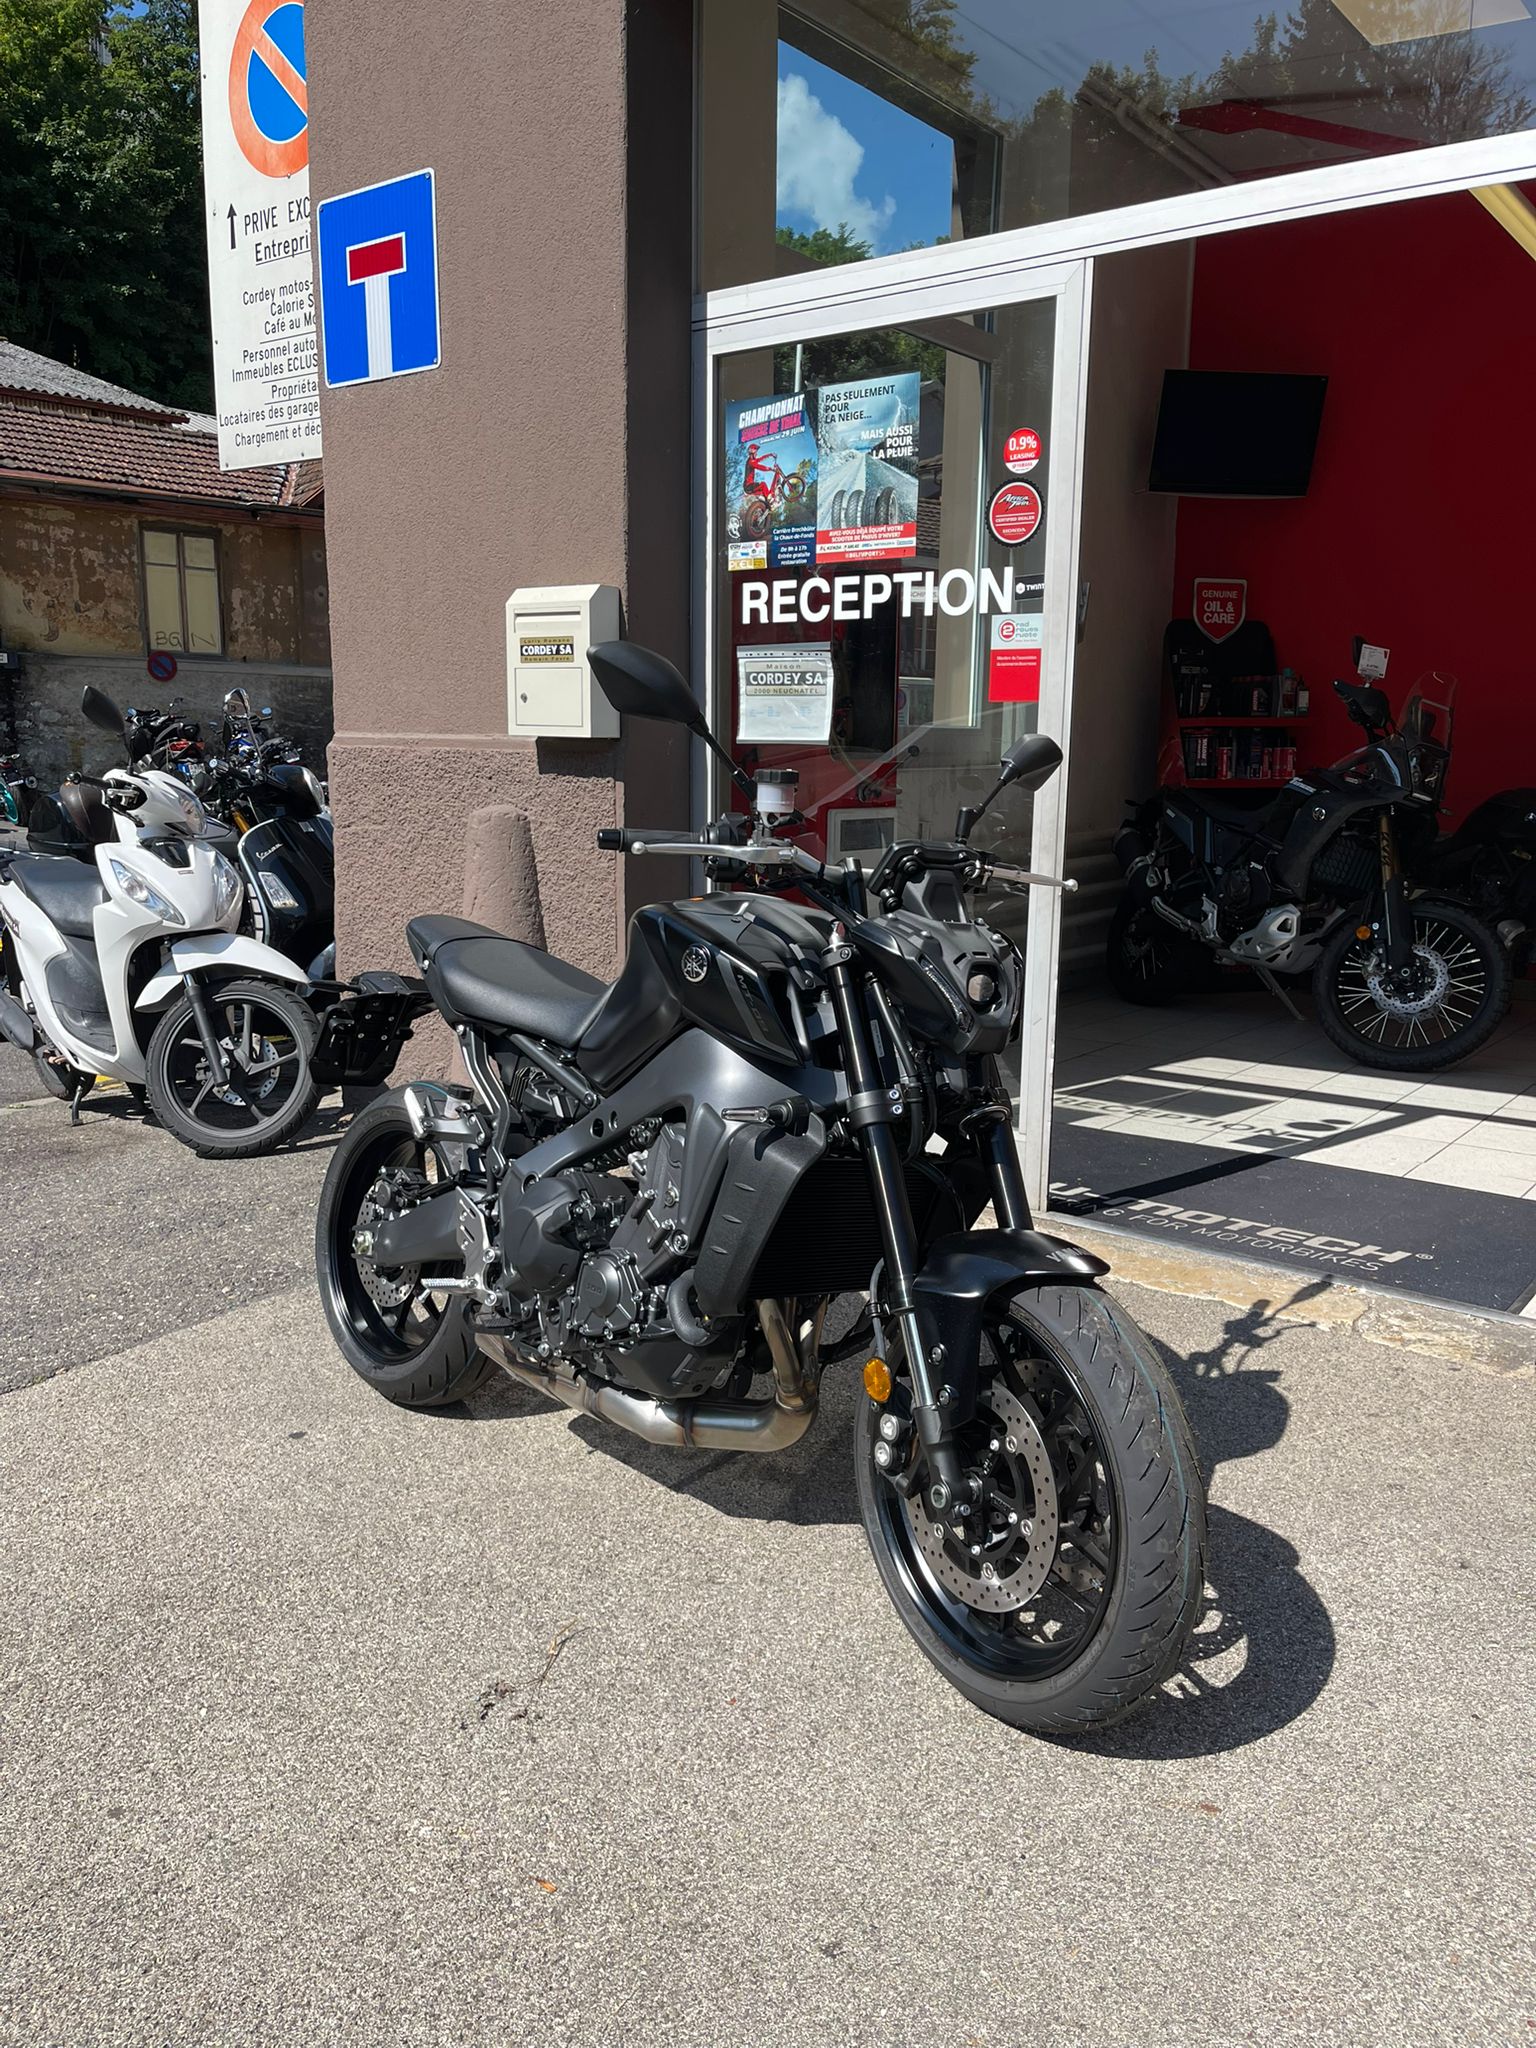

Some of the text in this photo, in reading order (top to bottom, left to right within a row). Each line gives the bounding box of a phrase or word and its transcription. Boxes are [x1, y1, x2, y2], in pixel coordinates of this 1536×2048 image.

[244, 196, 311, 236] PRIVE EXC
[255, 230, 310, 262] Entrepri
[243, 279, 313, 305] Cordey motos-
[270, 297, 304, 316] Calorie
[264, 318, 286, 335] Café
[289, 317, 300, 330] au
[243, 341, 291, 364] Personnel
[231, 353, 319, 383] Immeubles ECLUS
[271, 379, 317, 400] Propriéta
[825, 385, 895, 403] PAS SEULEMENT
[219, 400, 319, 427] Locataires des garage
[738, 394, 805, 429] CHAMPIONNAT
[825, 402, 849, 413] POUR
[825, 410, 872, 424] LA NEIGE...
[235, 421, 321, 447] Chargement et déc
[791, 426, 805, 436] JUIN
[861, 424, 913, 440] MAIS AUSSI
[886, 435, 913, 447] POUR
[1009, 435, 1037, 451] 0.9%
[873, 446, 913, 460] LA PLUIE
[742, 566, 1014, 625] RECEPTION
[1202, 590, 1238, 599] GENUINE
[1204, 600, 1234, 612] OIL &
[1203, 612, 1235, 624] CARE
[522, 644, 572, 655] CORDEY SA
[749, 672, 824, 685] CORDEY SA
[1128, 1214, 1188, 1231] FOR
[1191, 1227, 1385, 1272] MOTORBIKES
